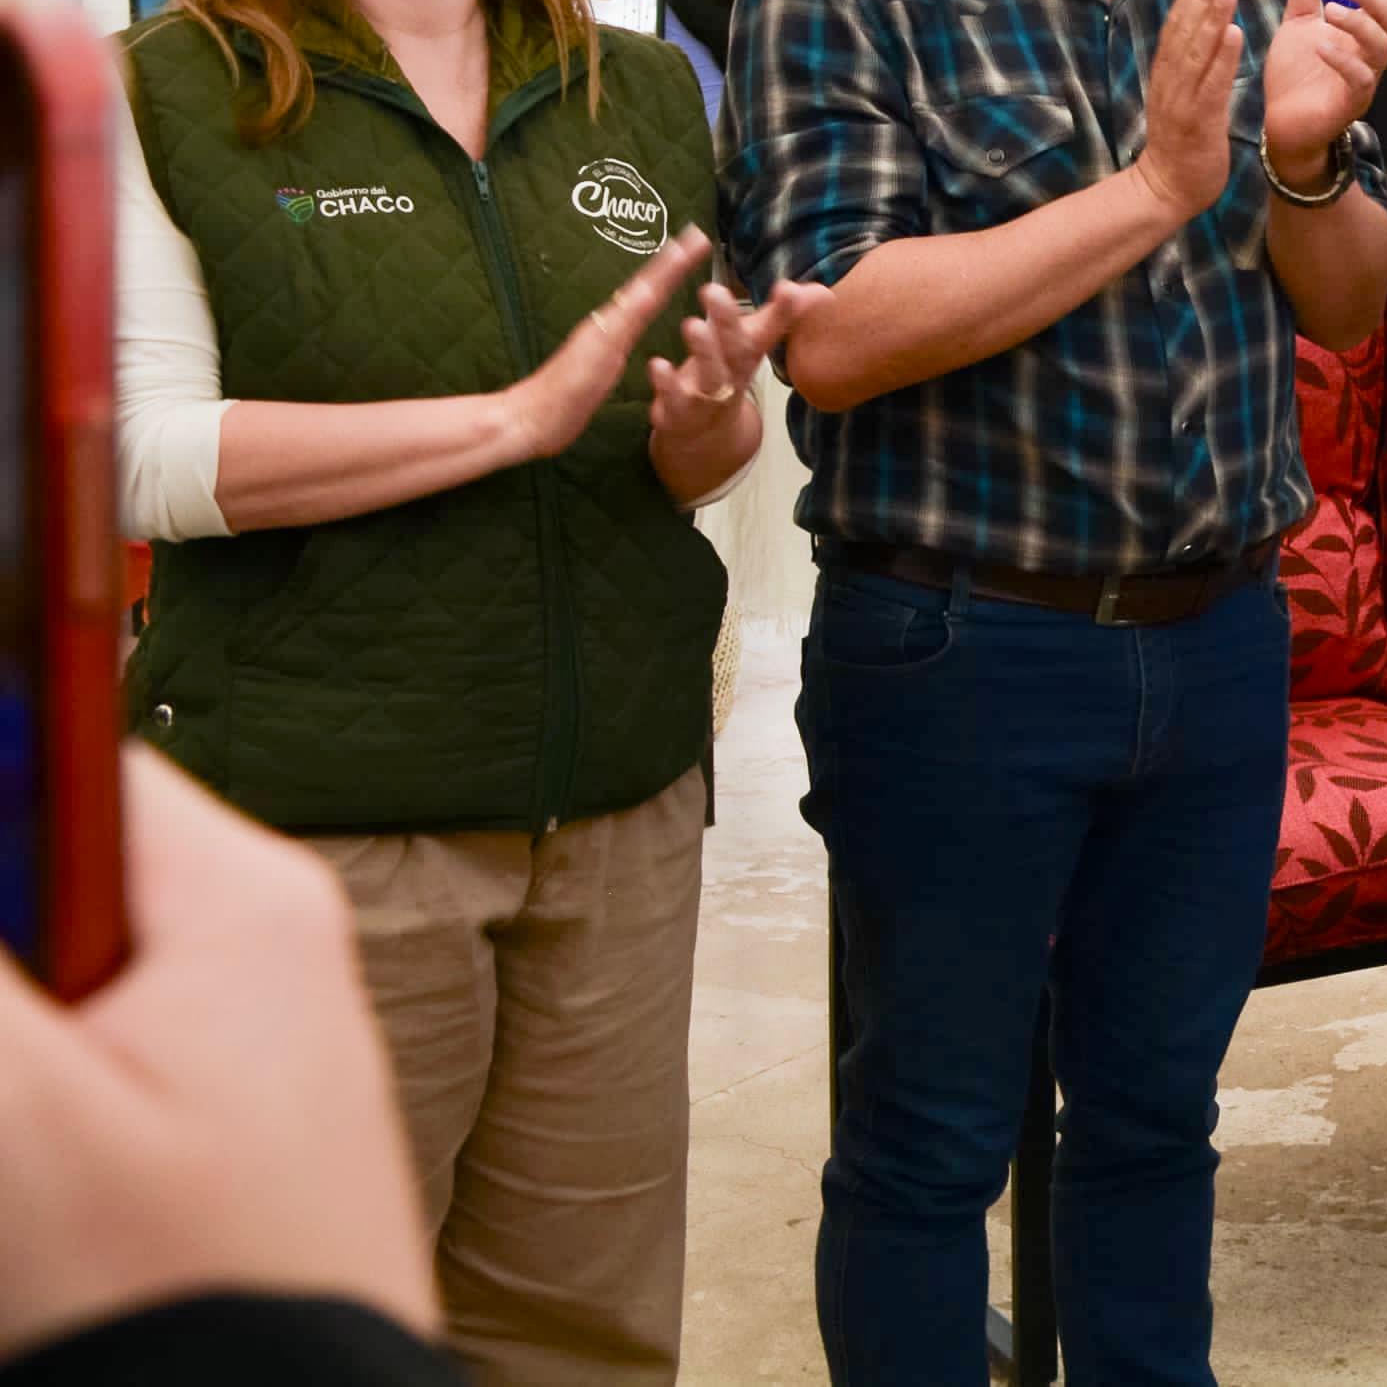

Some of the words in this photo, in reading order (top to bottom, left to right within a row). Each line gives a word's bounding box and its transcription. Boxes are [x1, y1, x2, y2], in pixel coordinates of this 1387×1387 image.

[316, 186, 369, 199] Gobierno
[370, 185, 387, 195] del
[572, 181, 661, 223] Chaco
[320, 195, 415, 217] CHACO
